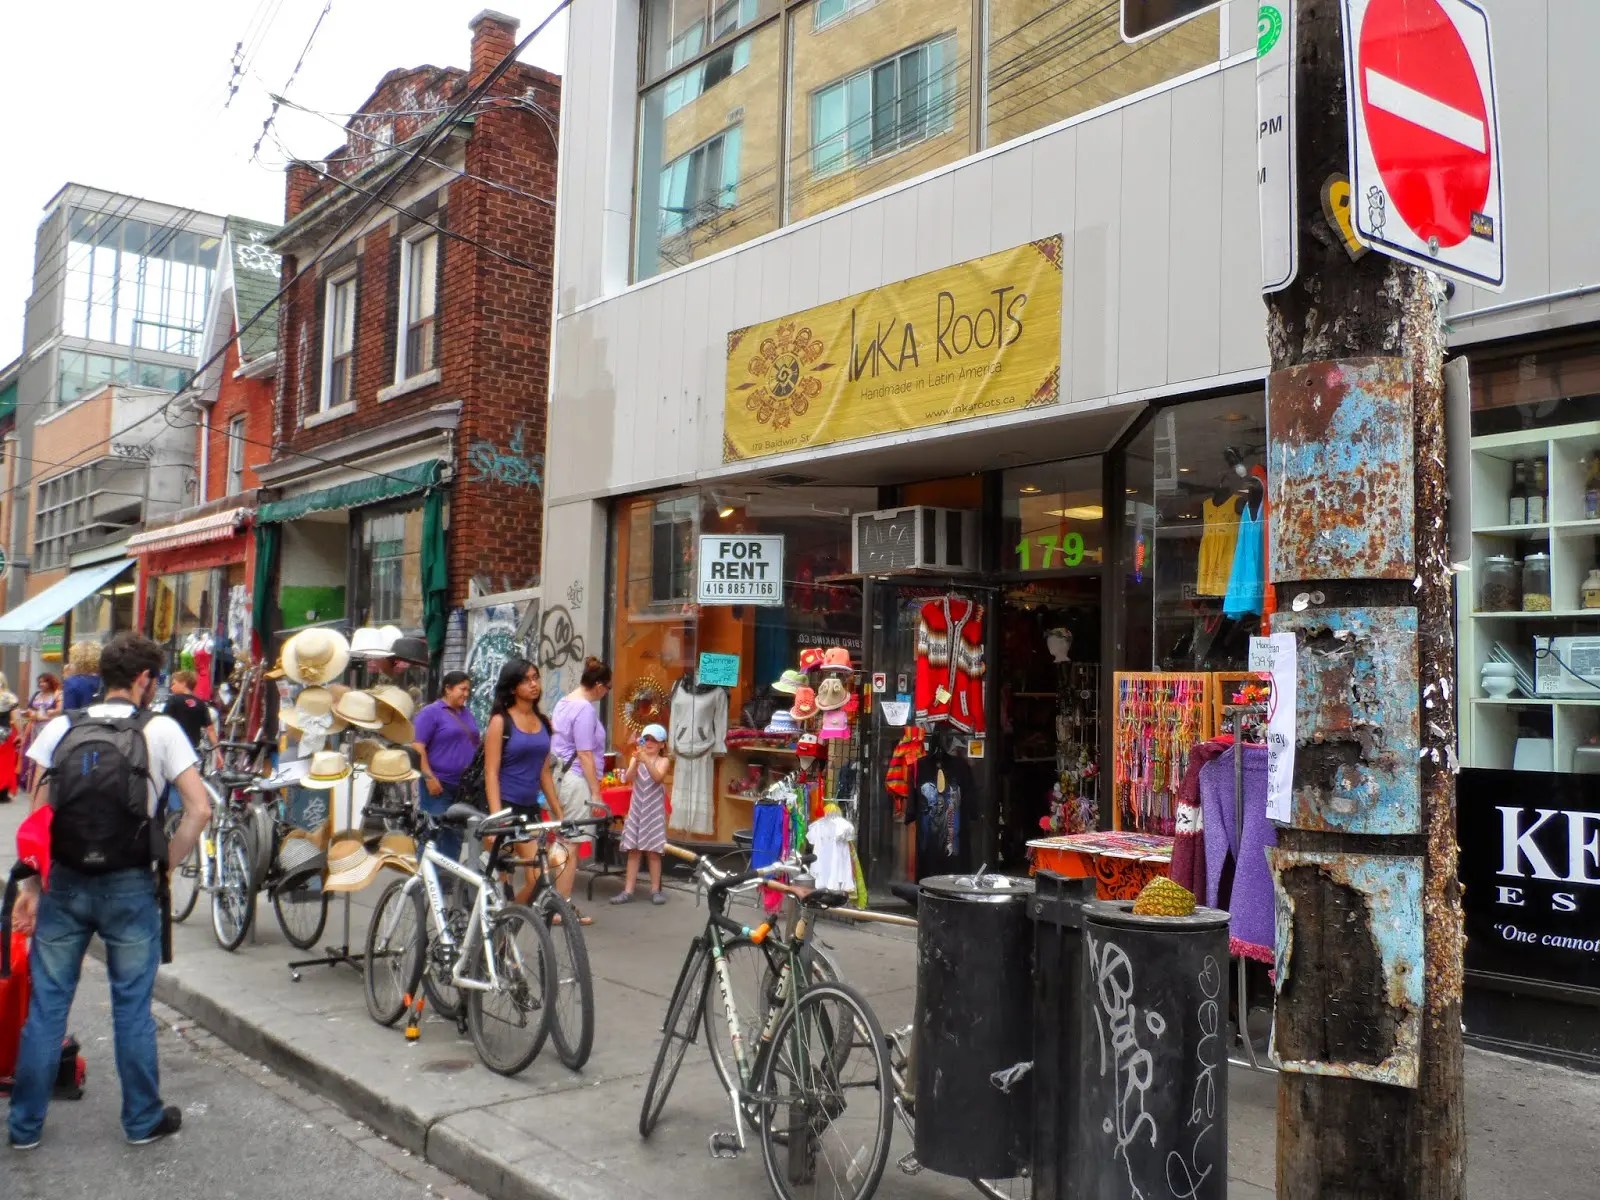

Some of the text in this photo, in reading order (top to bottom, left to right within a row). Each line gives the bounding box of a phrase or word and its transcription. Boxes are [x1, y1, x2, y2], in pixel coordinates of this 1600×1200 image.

[860, 361, 1003, 400] Handmade in Latin America
[925, 395, 1016, 419] www.inkaroots.ca
[752, 433, 810, 451] 179 Baldwin St
[719, 542, 762, 559] FOR
[1015, 532, 1084, 570] 179
[711, 561, 770, 580] RENT
[706, 583, 773, 594] 416 885 7166
[702, 654, 736, 666] Summer
[1541, 934, 1600, 952] cannot
